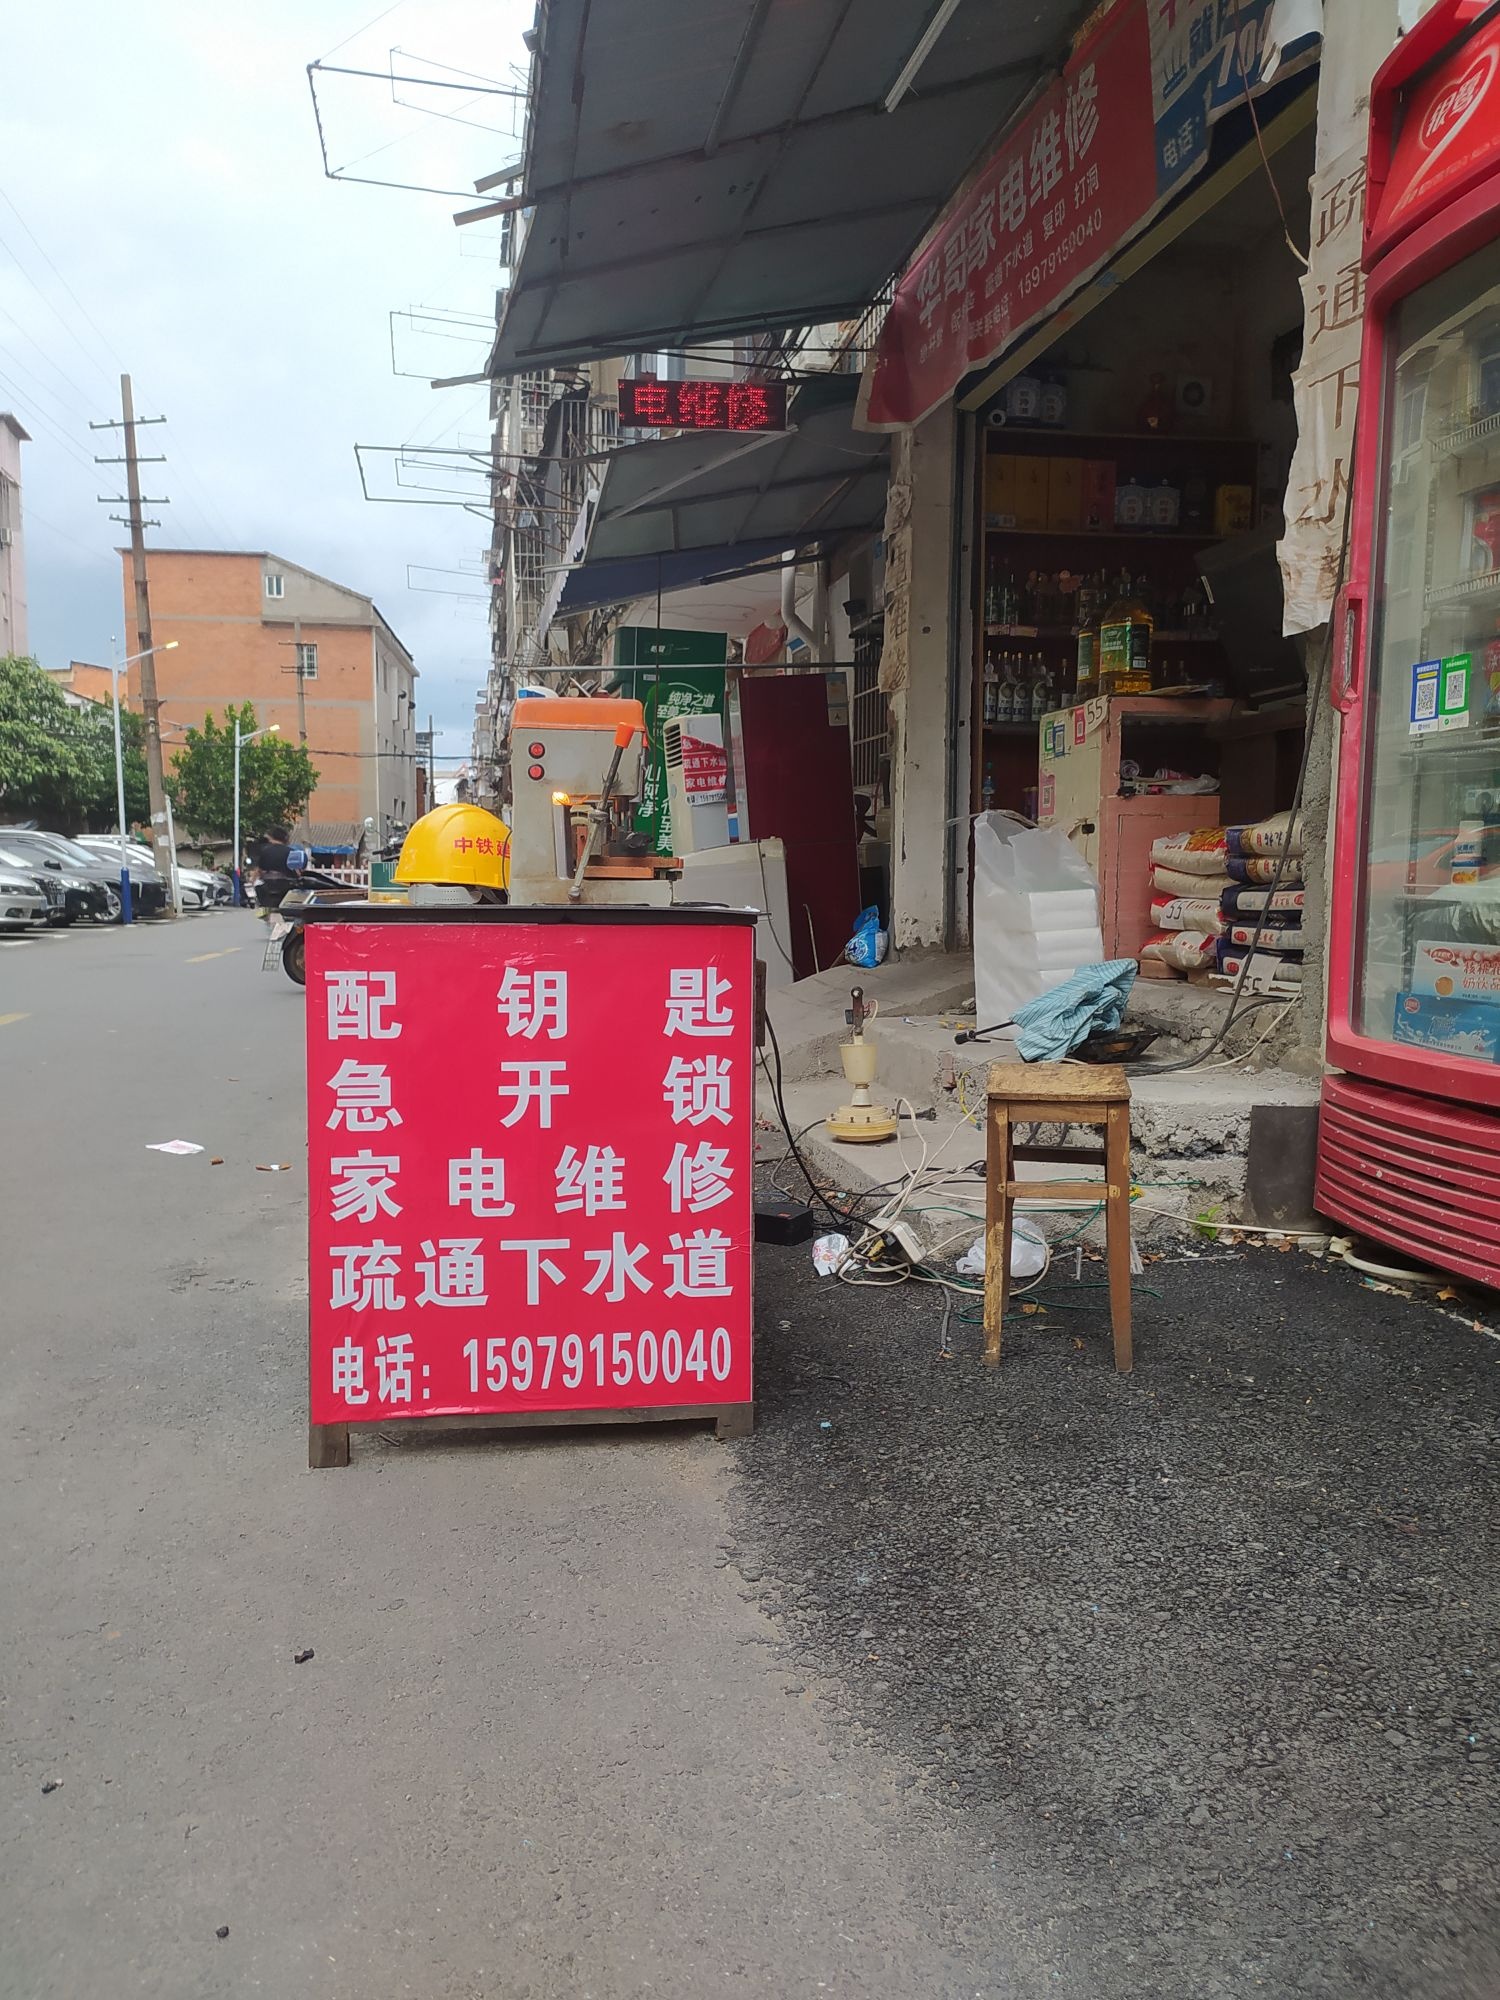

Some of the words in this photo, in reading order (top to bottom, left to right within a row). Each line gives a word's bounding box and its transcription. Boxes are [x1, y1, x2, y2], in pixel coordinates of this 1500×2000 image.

[917, 62, 1100, 328] 华哥家电维修
[1041, 198, 1066, 242] 复印
[1073, 162, 1100, 210] 打洞
[1017, 207, 1103, 300] 15979150040
[1086, 700, 1103, 725] 55
[685, 773, 728, 788] 家电维修
[454, 836, 511, 859] 中铁建
[324, 966, 736, 1040] 配钥匙
[325, 1054, 733, 1133] 急开锁
[329, 1140, 735, 1224] 家电维修
[328, 1228, 735, 1312] 疏通下水道
[331, 1332, 431, 1405] 电话：
[462, 1326, 732, 1393] 15979150040
